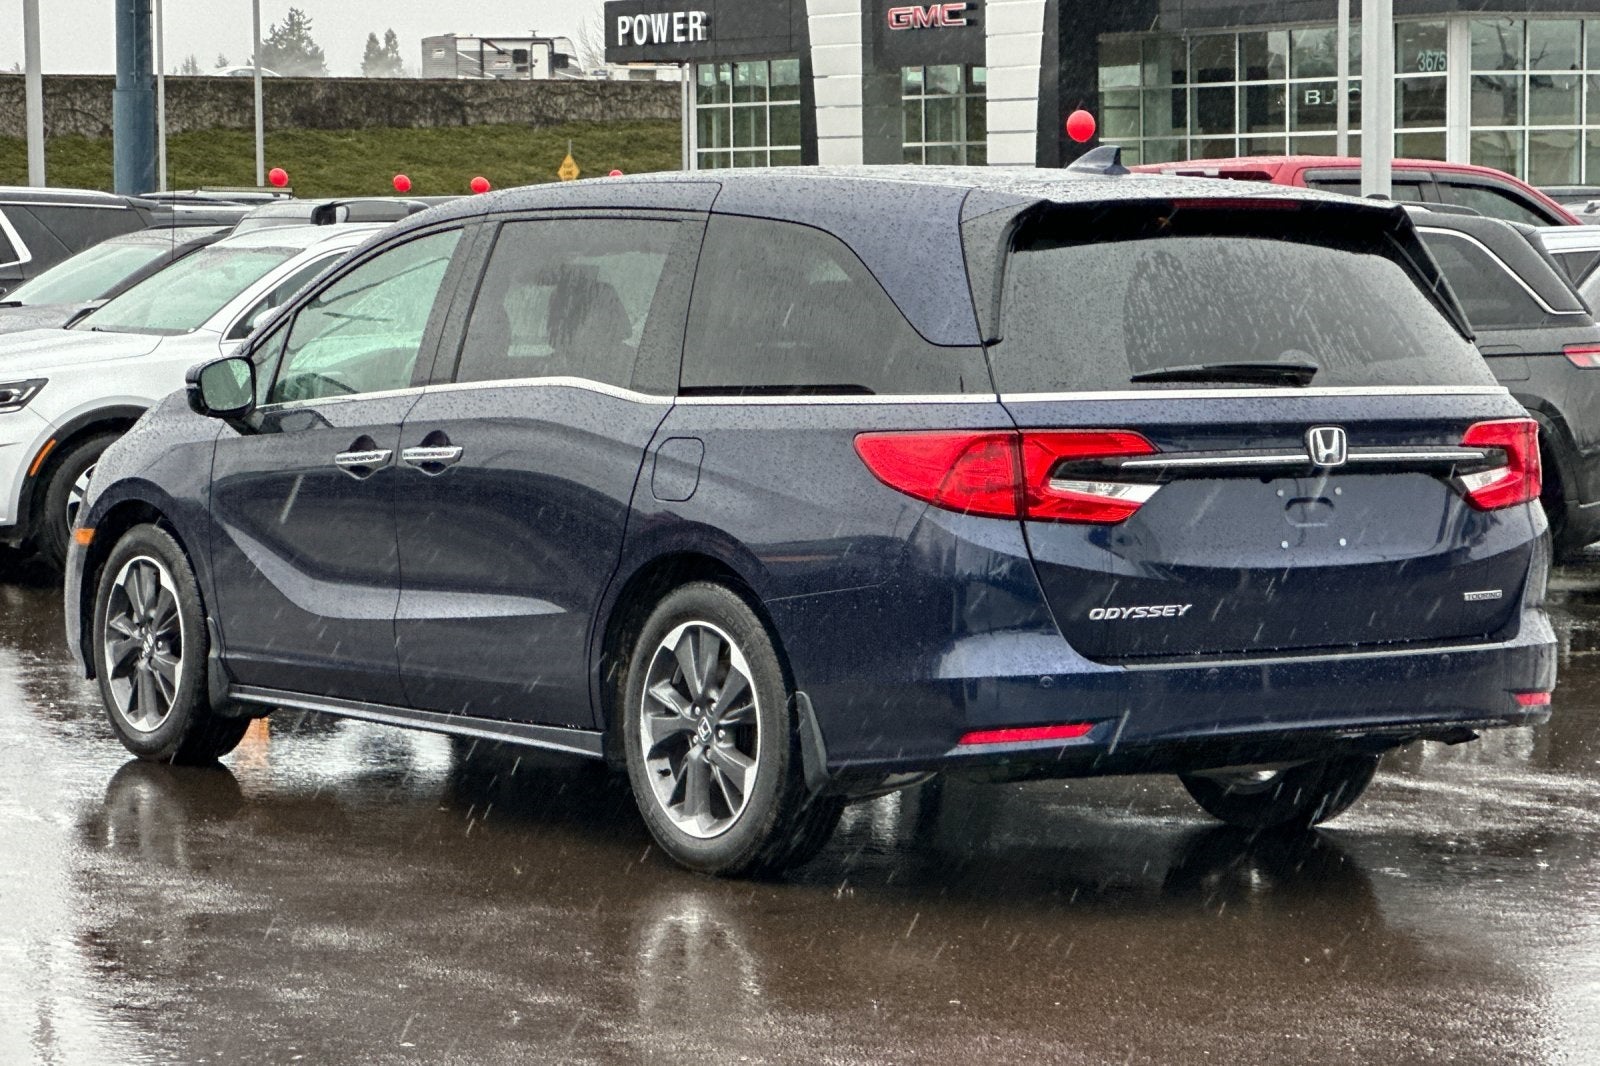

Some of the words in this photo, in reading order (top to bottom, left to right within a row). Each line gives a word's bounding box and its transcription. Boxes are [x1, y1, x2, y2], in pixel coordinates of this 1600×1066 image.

[888, 2, 967, 30] GMC
[617, 10, 707, 46] POWER
[1417, 50, 1447, 72] 3675
[1464, 591, 1502, 601] TOURING
[1088, 604, 1193, 621] ODYSSEY
